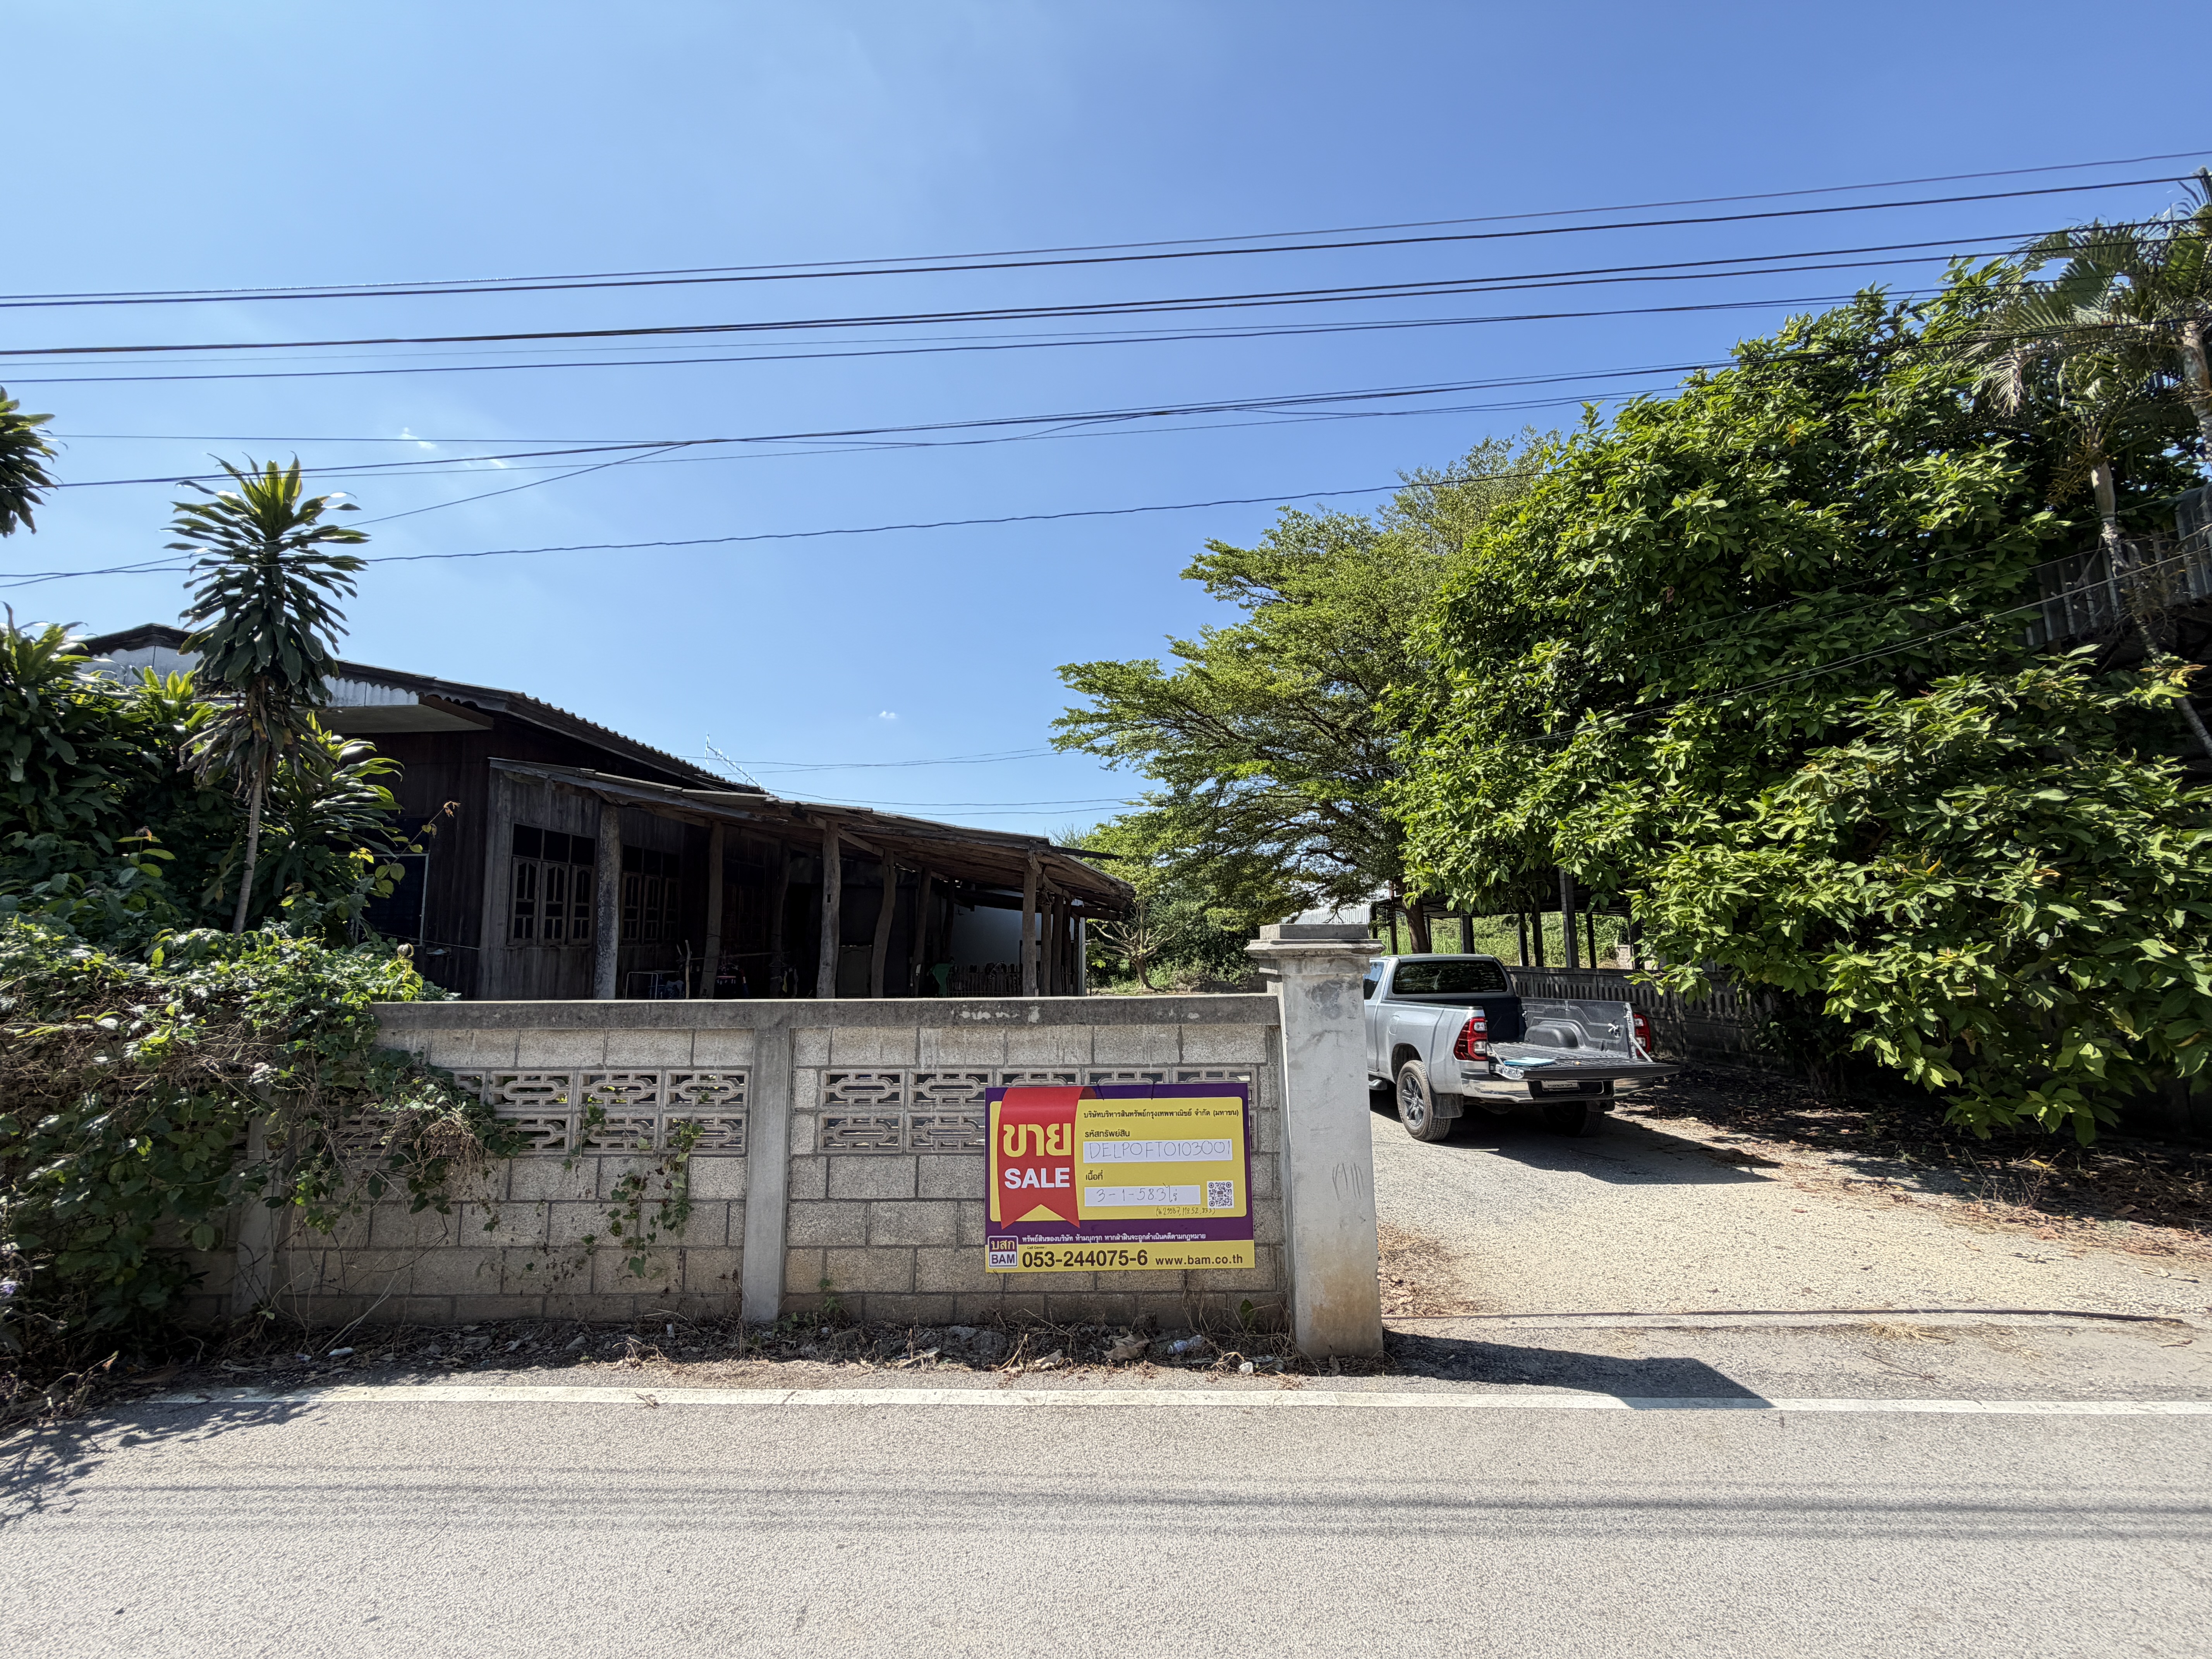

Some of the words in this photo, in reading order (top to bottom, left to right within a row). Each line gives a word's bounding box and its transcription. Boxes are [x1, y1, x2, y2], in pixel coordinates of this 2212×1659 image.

[1084, 1128, 1130, 1138] รหัสทรัพย์สิน
[1003, 1123, 1072, 1158] ขาย
[1005, 1167, 1070, 1189] SALE
[1085, 1169, 1103, 1181] เนื้อที่
[1022, 1234, 1073, 1242] ทรัพย์สินของบริษัท
[1075, 1233, 1103, 1243] ห้ามบุกรุก
[991, 1239, 1015, 1250] บสก
[991, 1254, 1015, 1264] BAM
[1022, 1249, 1148, 1268] 053-244075-6
[1155, 1254, 1243, 1265] www.bam.co.th
